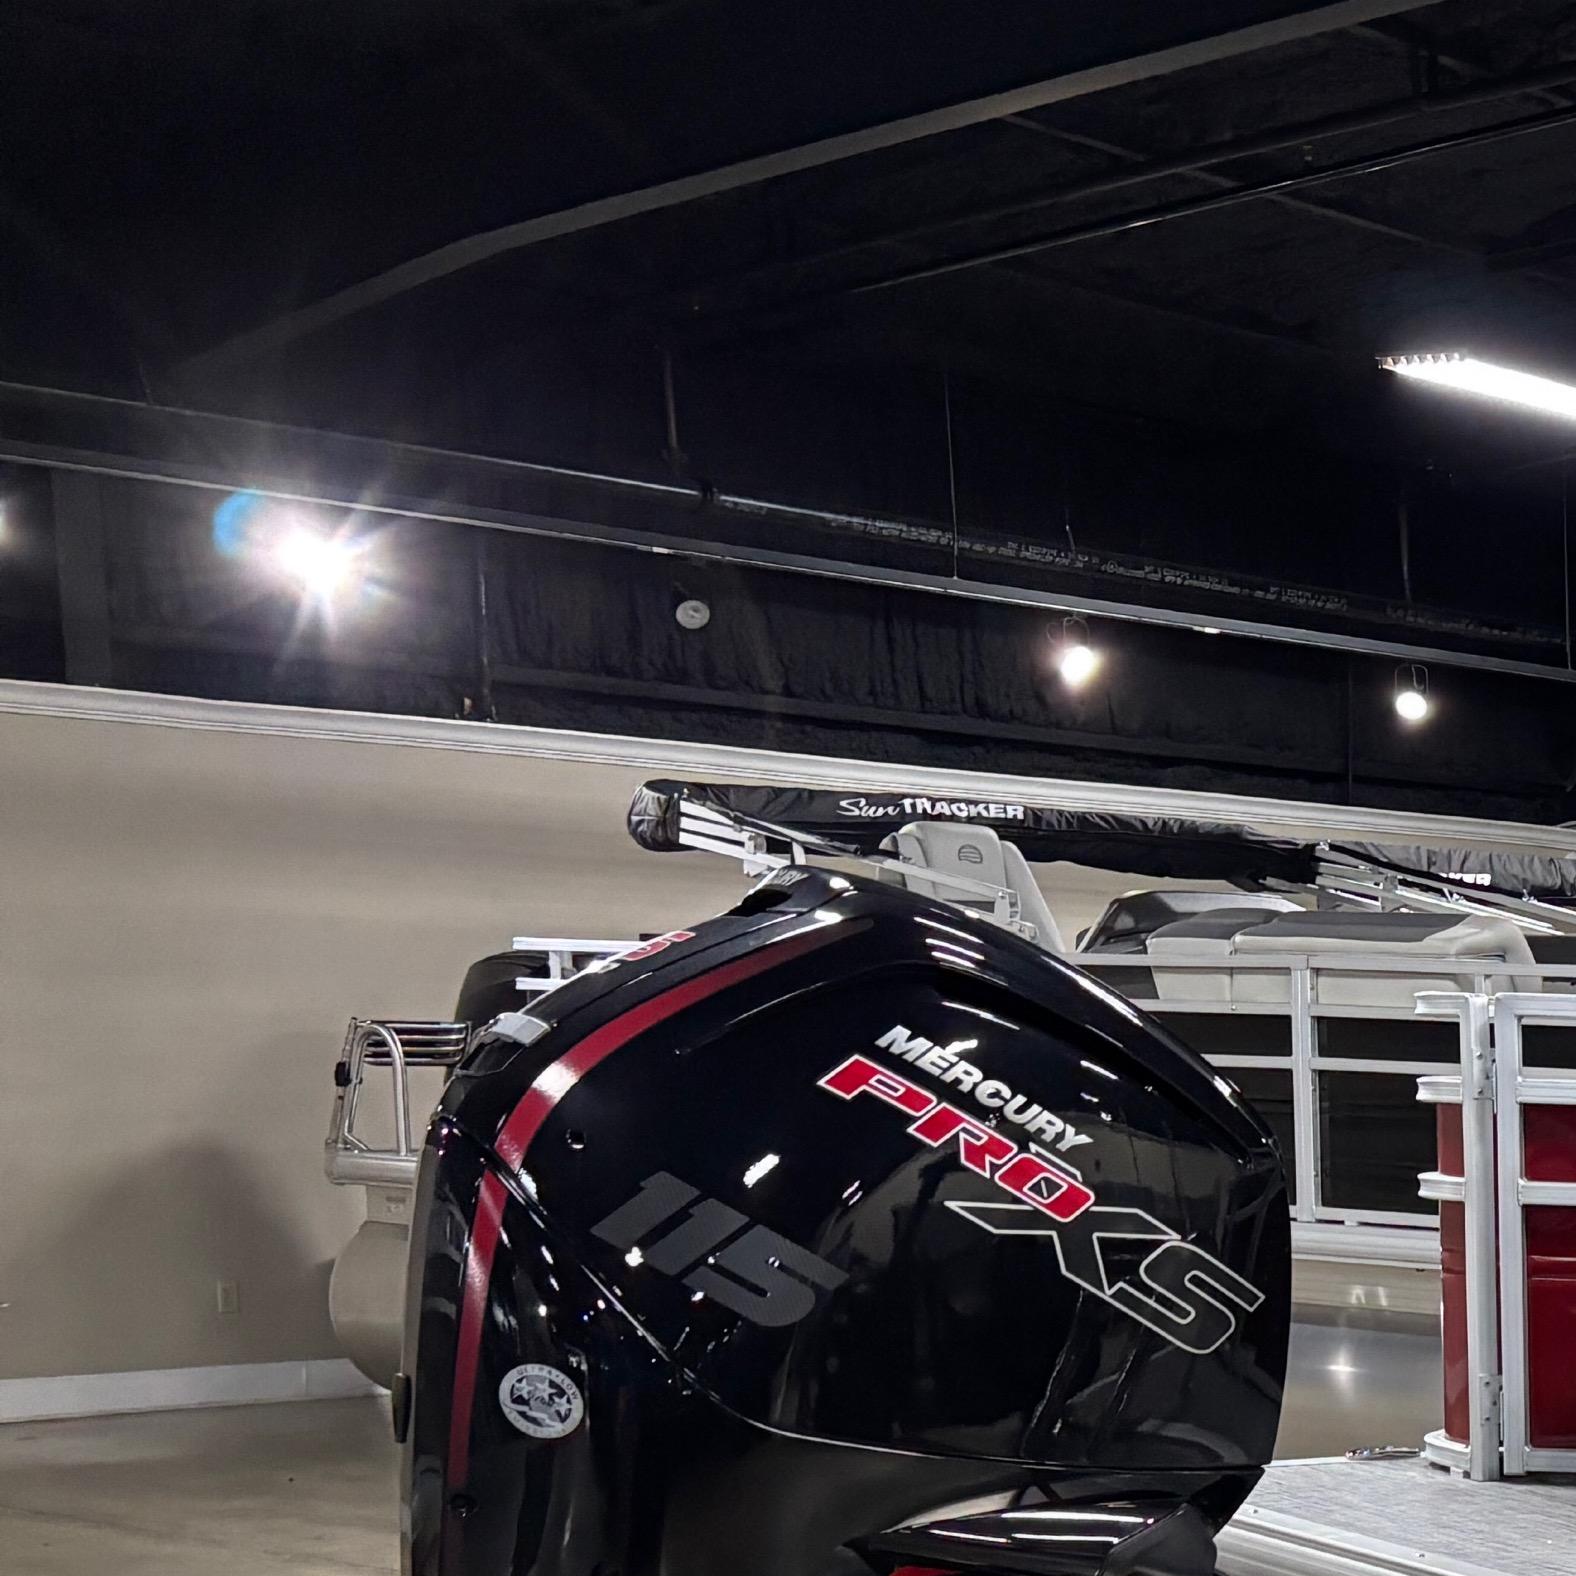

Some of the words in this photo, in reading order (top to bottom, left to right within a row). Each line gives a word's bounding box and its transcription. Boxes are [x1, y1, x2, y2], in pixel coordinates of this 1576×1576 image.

[836, 797, 899, 818] Sun
[898, 797, 1025, 820] TRACKER
[816, 1054, 1096, 1223] PRO
[874, 1025, 1094, 1153] MERCURY
[591, 1171, 850, 1327] 115
[944, 1142, 1266, 1354] XS
